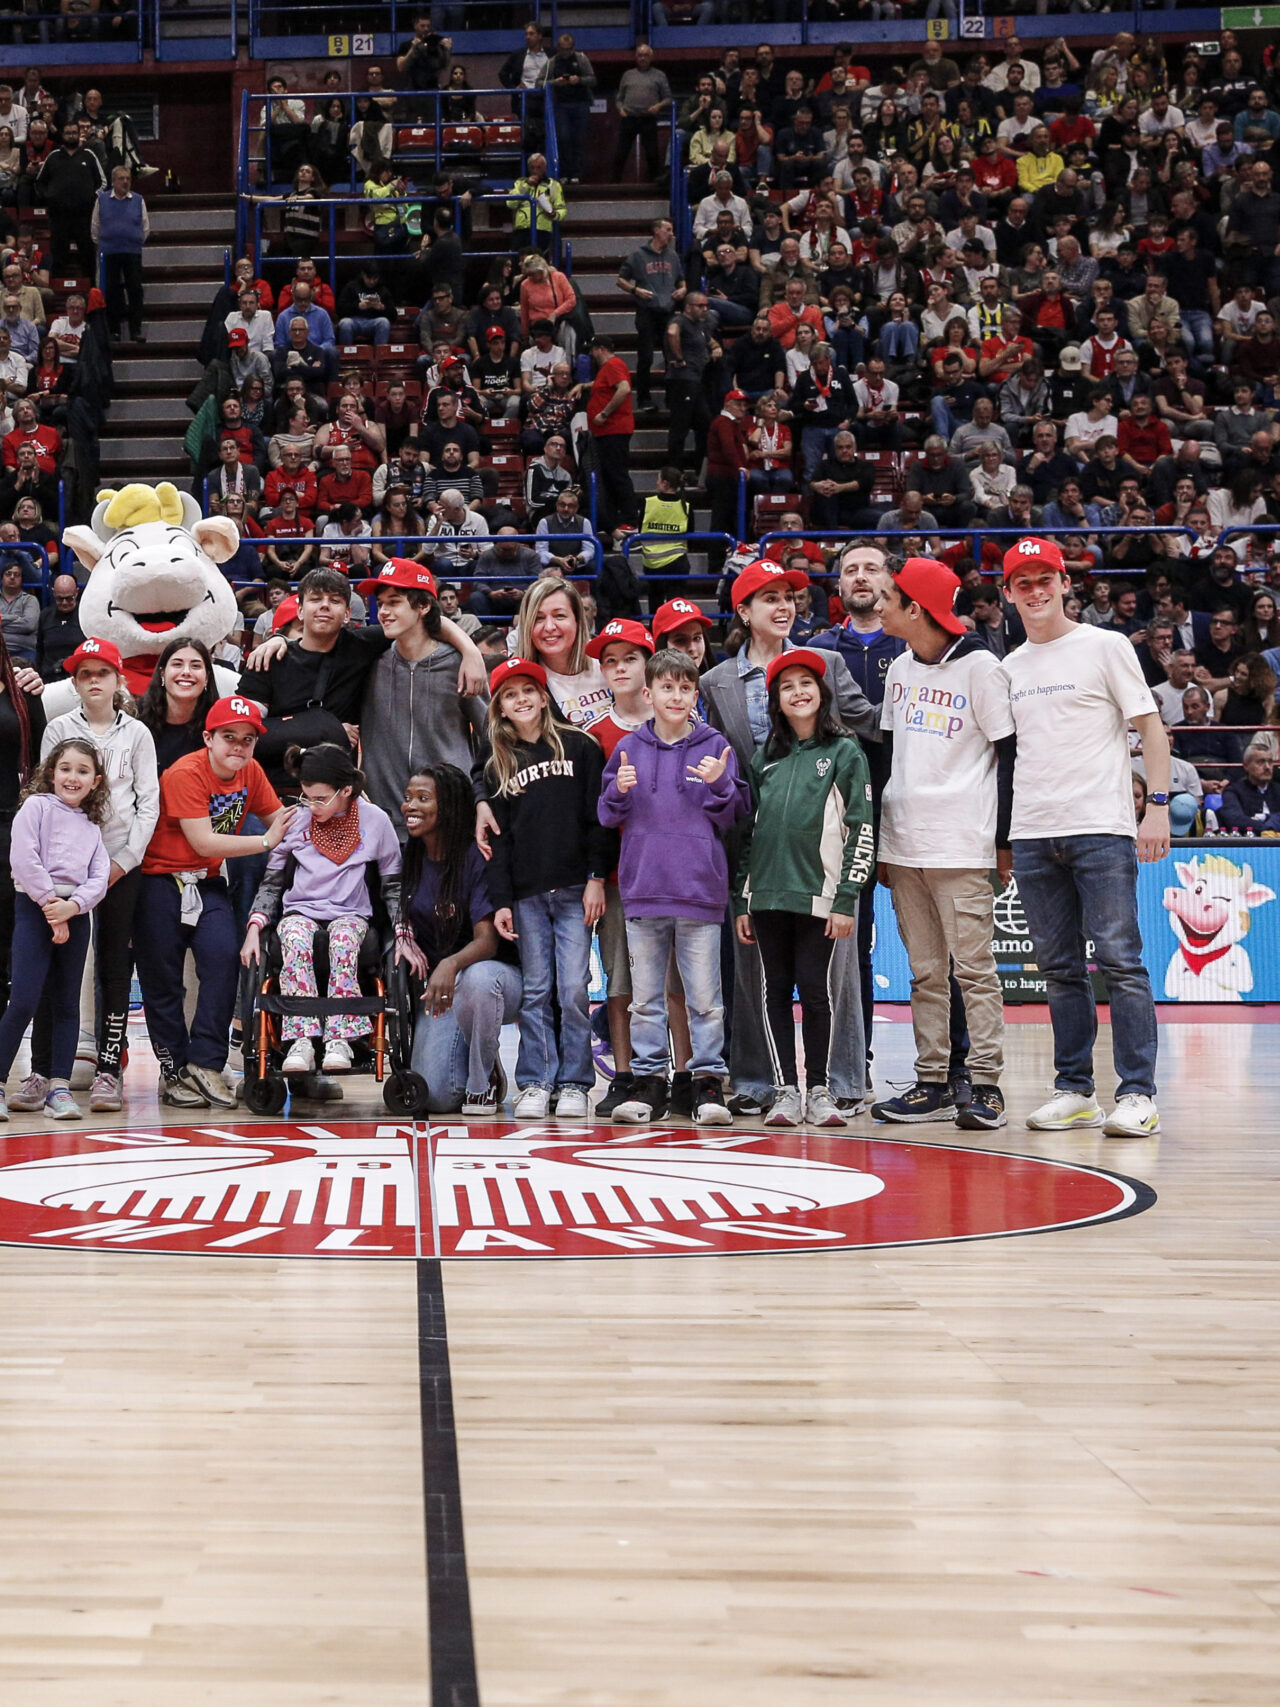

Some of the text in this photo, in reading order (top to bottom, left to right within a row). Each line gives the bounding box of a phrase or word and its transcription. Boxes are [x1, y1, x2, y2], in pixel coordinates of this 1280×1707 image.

[965, 20, 983, 33] 22
[334, 37, 342, 46] B
[355, 38, 371, 51] 21
[891, 683, 968, 711] Dynamo
[1037, 683, 1076, 695] happiness
[905, 702, 964, 739] Camp
[103, 747, 129, 779] VE
[848, 822, 874, 884] BUCKS
[990, 939, 1034, 953] amo
[1004, 977, 1017, 989] to
[100, 1012, 126, 1065] #suit
[85, 1125, 771, 1149] OLIMPIA
[29, 1219, 847, 1252] MILANO
